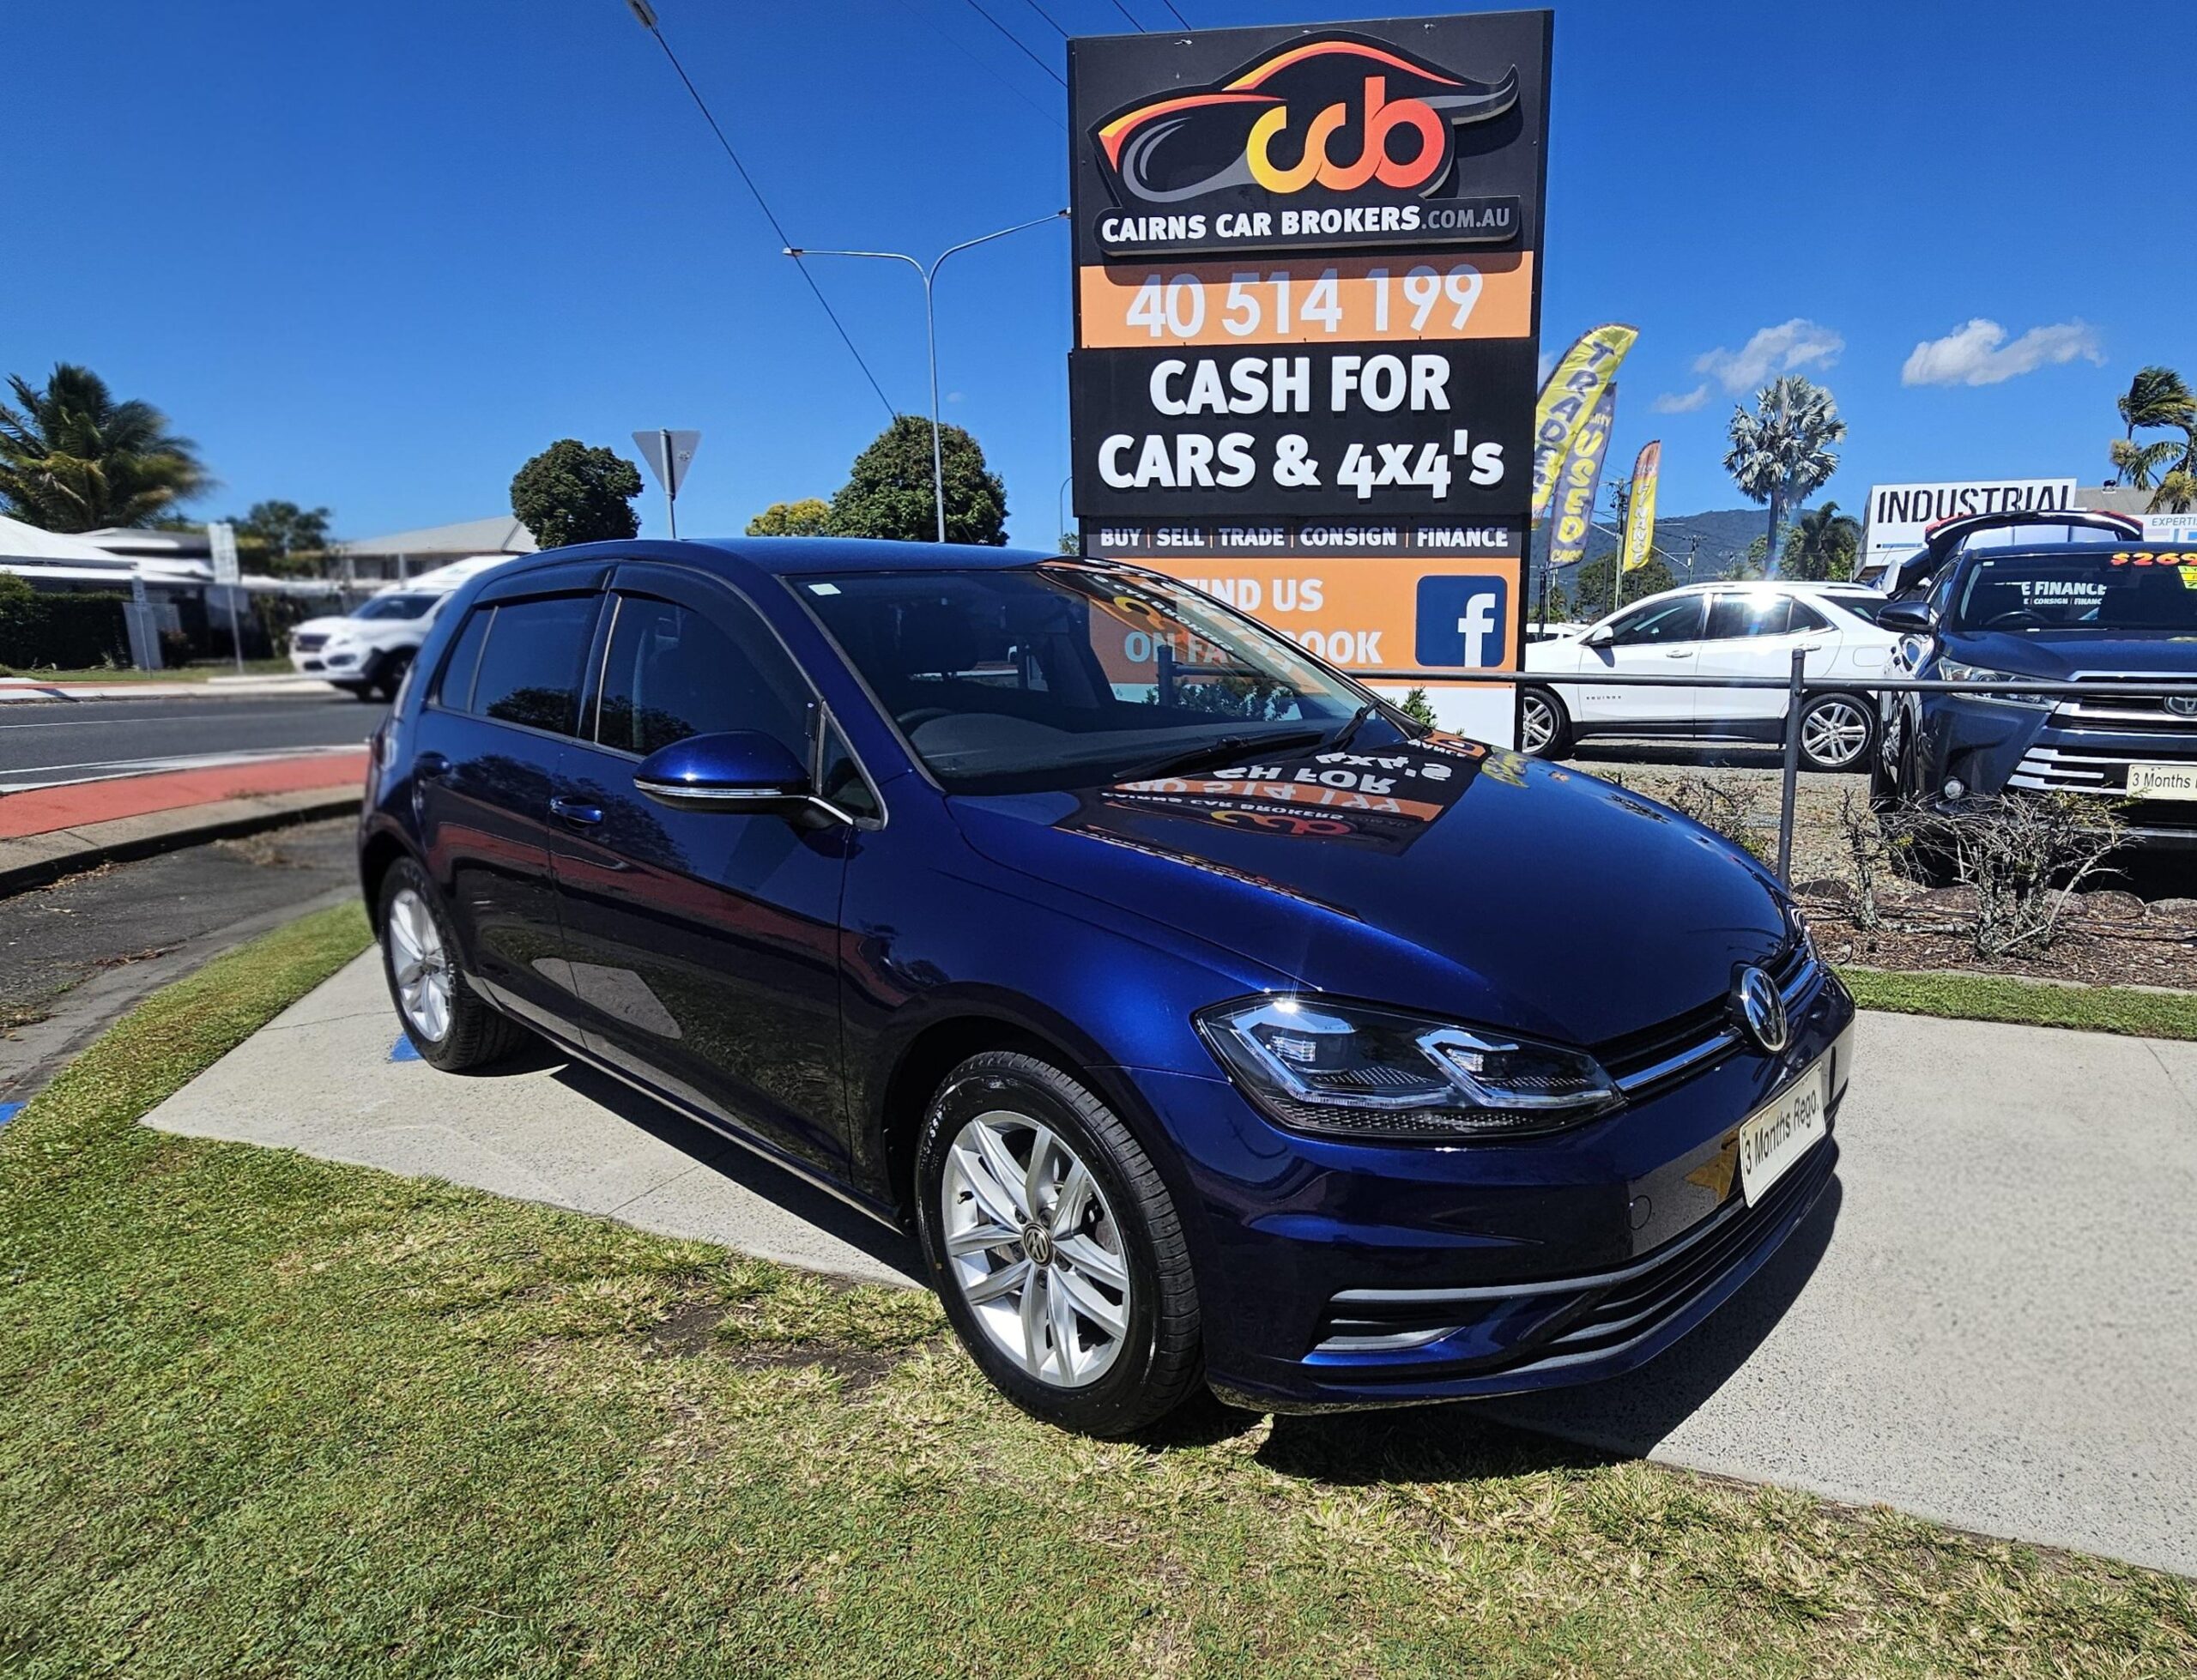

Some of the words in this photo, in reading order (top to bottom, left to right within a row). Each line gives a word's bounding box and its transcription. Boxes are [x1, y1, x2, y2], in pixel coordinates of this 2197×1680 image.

[1101, 214, 1207, 243] CAIRNS
[1216, 211, 1272, 238] CAR
[1127, 273, 1205, 338] 40
[1221, 269, 1342, 335] 514
[1364, 263, 1484, 332] 199
[1149, 357, 1310, 415] CASH
[1331, 354, 1450, 411] FOR
[1098, 432, 1256, 488] CARS
[1273, 434, 1322, 487] &
[1557, 429, 1604, 543] USED
[1877, 485, 2070, 523] INDUSTRIAL
[1101, 528, 1142, 547] BUY
[1157, 528, 1205, 547] SELL
[1219, 528, 1285, 547] TRADE
[1300, 527, 1397, 547] CONSIGN
[1418, 527, 1508, 547] FINANCE
[2152, 517, 2197, 527] EXPERTI
[1273, 578, 1323, 612] US
[2035, 582, 2107, 595] FINANCE
[2132, 772, 2140, 787] 3
[2144, 772, 2191, 789] Months
[1744, 1140, 1752, 1175] 3
[1754, 1115, 1791, 1166] Months
[1793, 1088, 1820, 1132] Rego.
